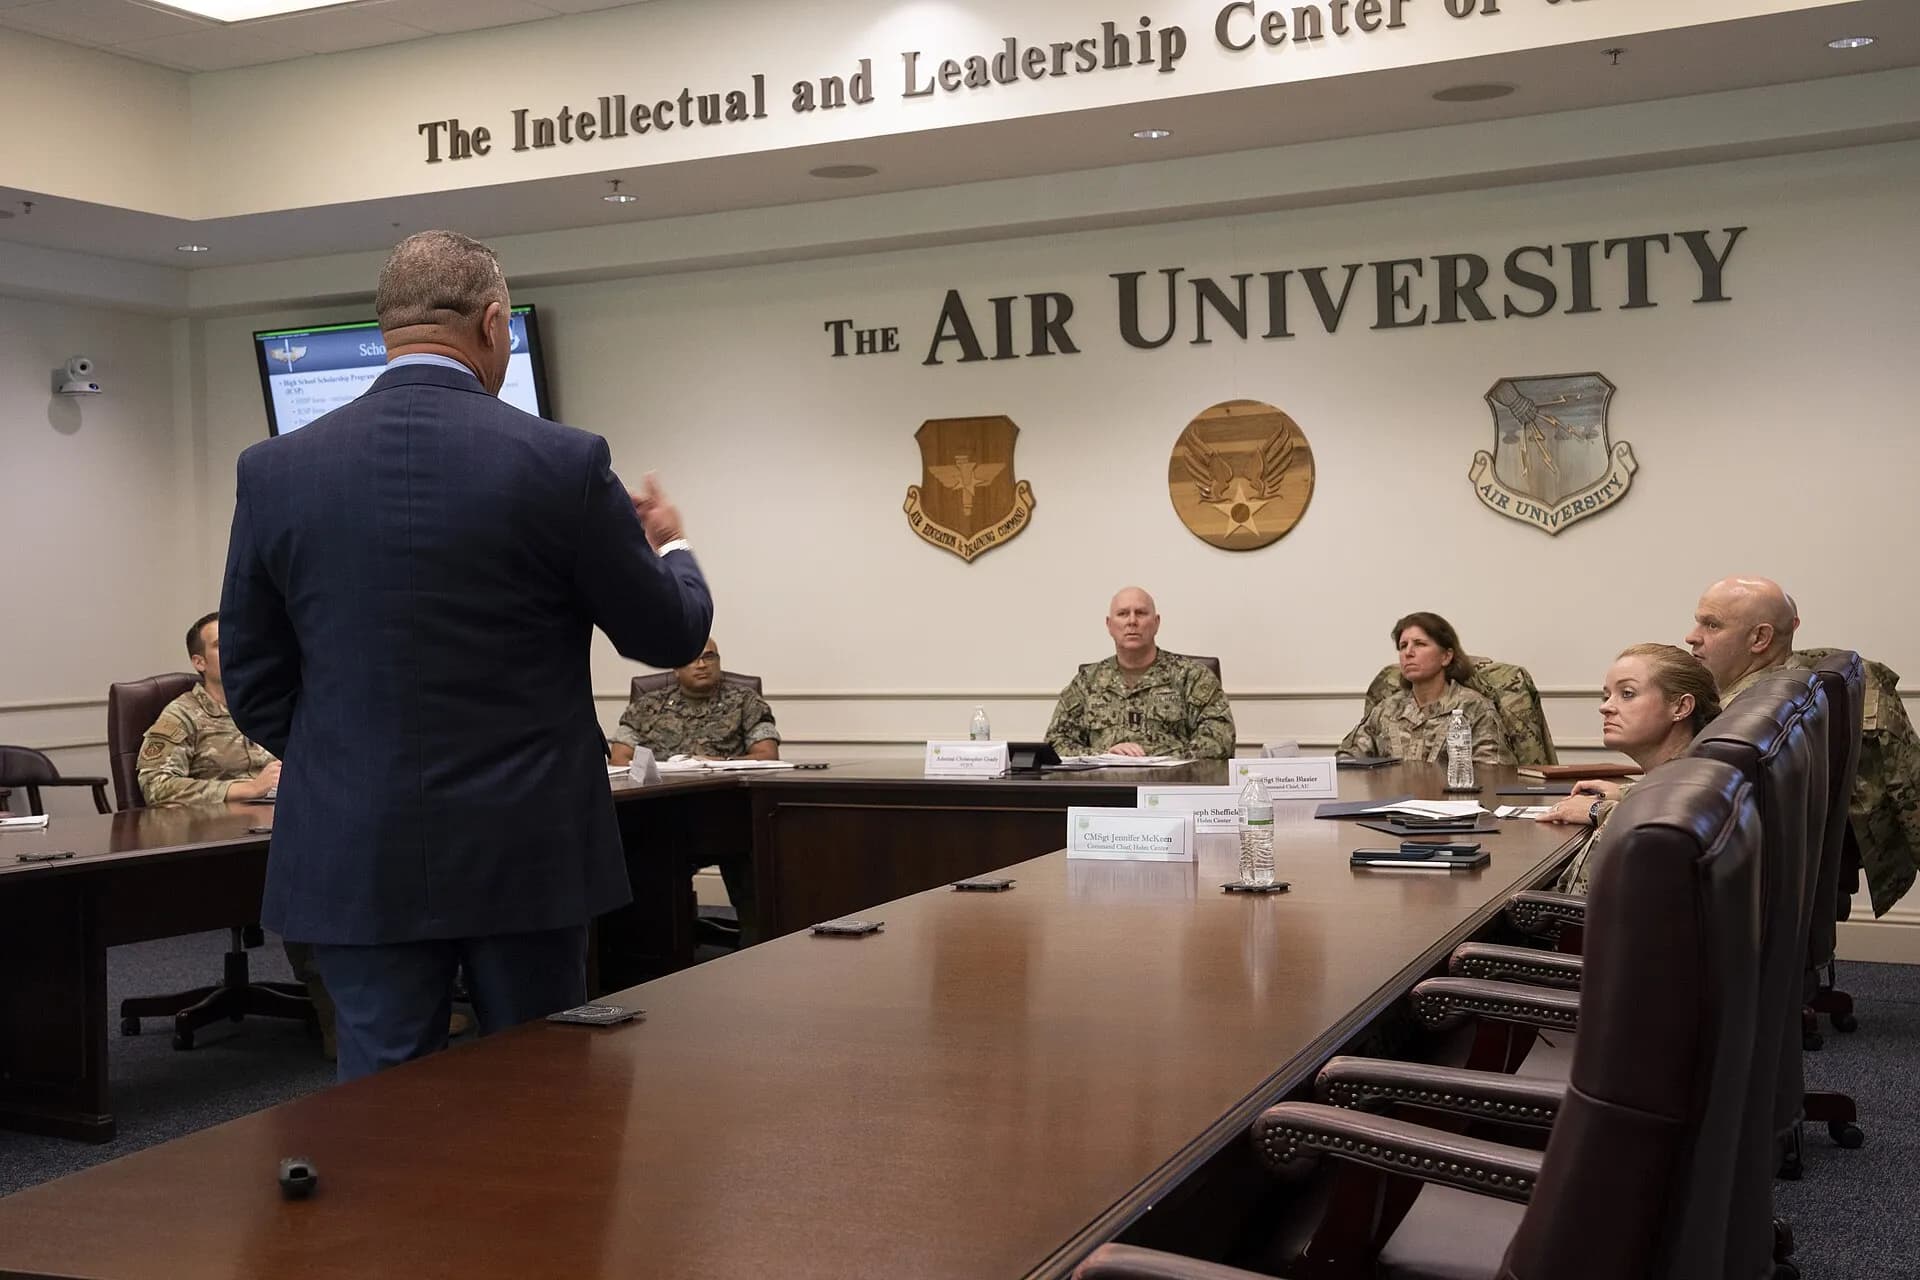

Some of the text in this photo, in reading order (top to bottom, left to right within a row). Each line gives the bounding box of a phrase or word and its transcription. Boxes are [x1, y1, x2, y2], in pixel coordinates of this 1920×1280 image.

[417, 119, 492, 164] The
[511, 74, 768, 152] Intellectual
[791, 59, 875, 113] and
[901, 16, 1187, 98] Leadership
[1215, 0, 1406, 51] Center
[921, 289, 1081, 366] AIR
[1108, 226, 1749, 350] UNIVERSITY
[1480, 472, 1624, 527] AIR UNIVERSITY
[922, 523, 957, 546] EDUCATION
[963, 530, 996, 557] TRAINING
[997, 506, 1026, 537] COMMAND
[1084, 832, 1109, 843] CMSgt
[1111, 833, 1140, 843] Jennifer
